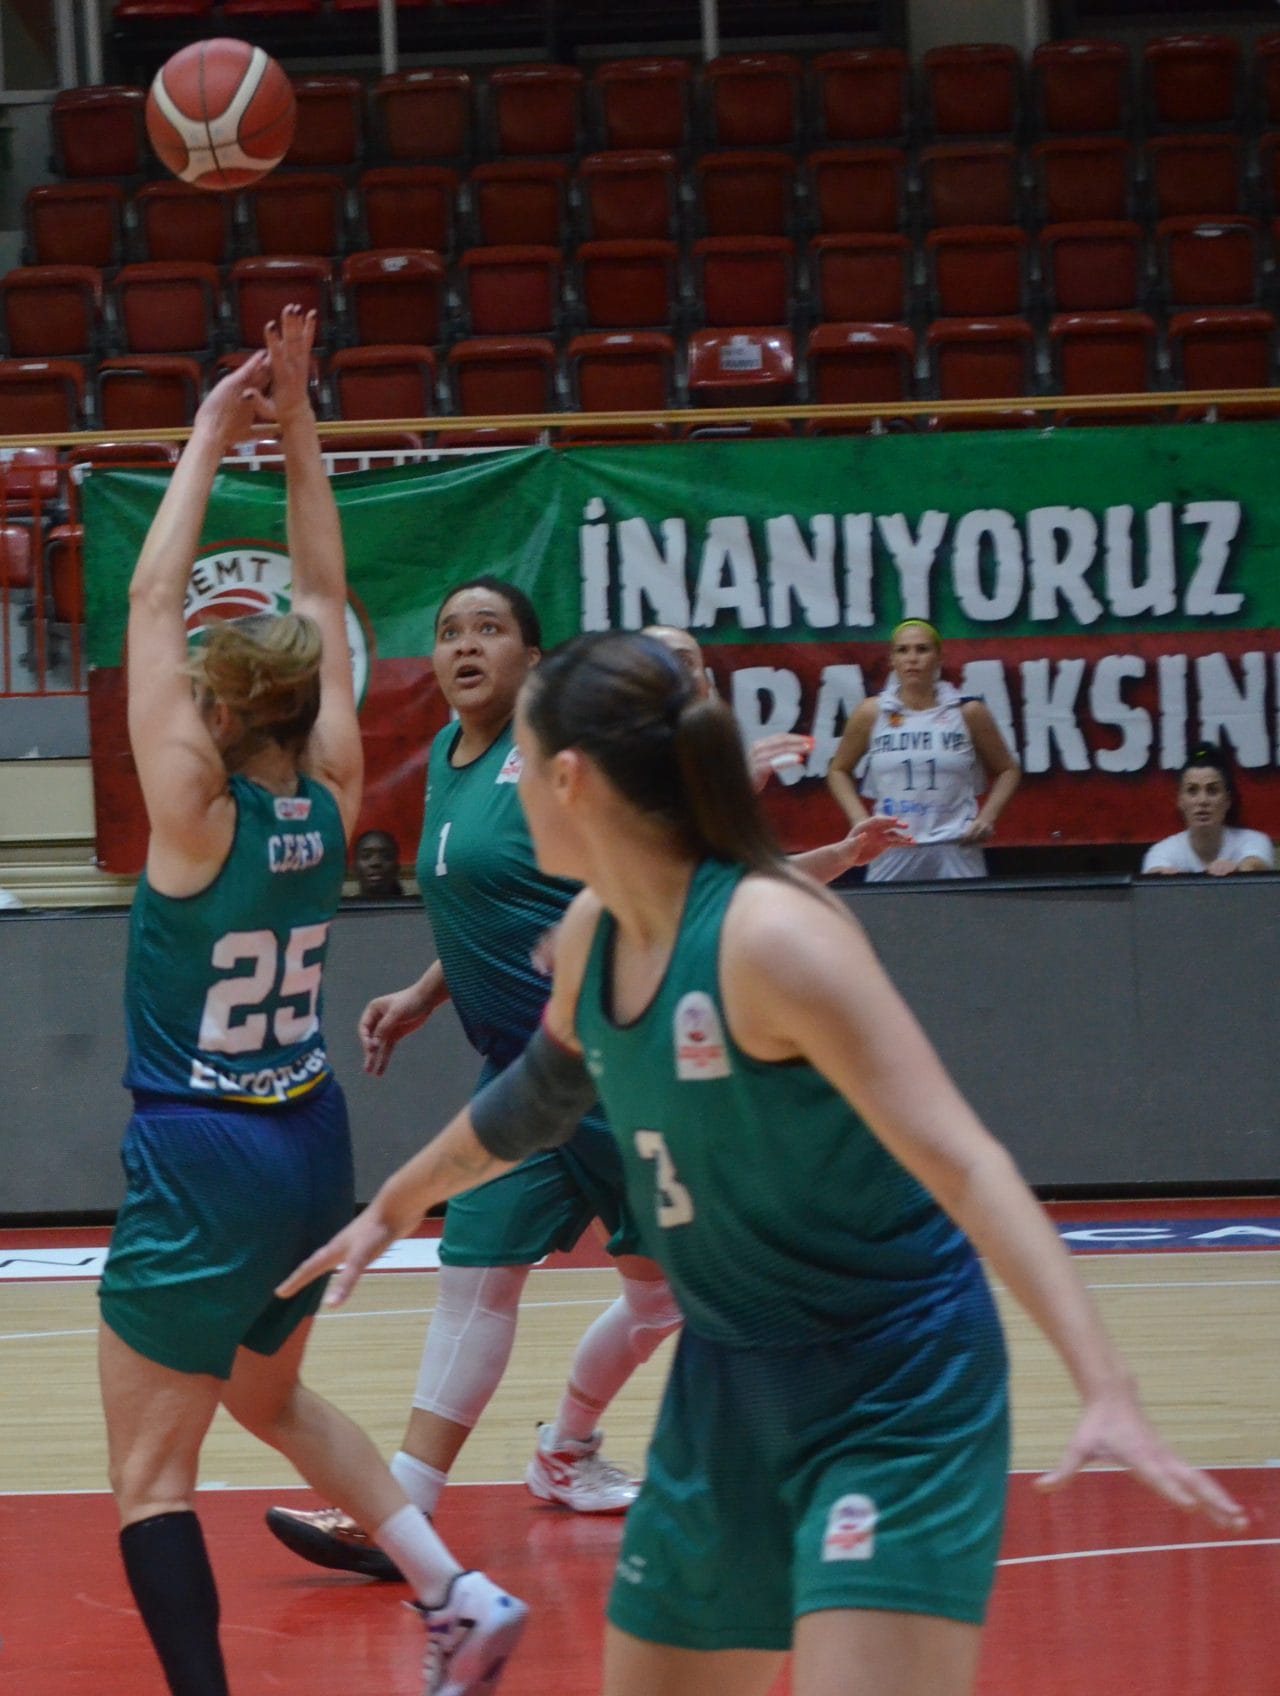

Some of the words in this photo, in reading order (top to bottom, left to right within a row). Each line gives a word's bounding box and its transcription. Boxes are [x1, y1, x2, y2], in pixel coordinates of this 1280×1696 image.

[184, 556, 271, 609] EMT
[580, 497, 1245, 632] İNANIYORUZ
[708, 651, 1280, 787] RAAKSIN
[900, 757, 938, 791] 11
[434, 821, 453, 877] 1
[198, 921, 332, 1055] 25
[634, 1129, 694, 1229] 3
